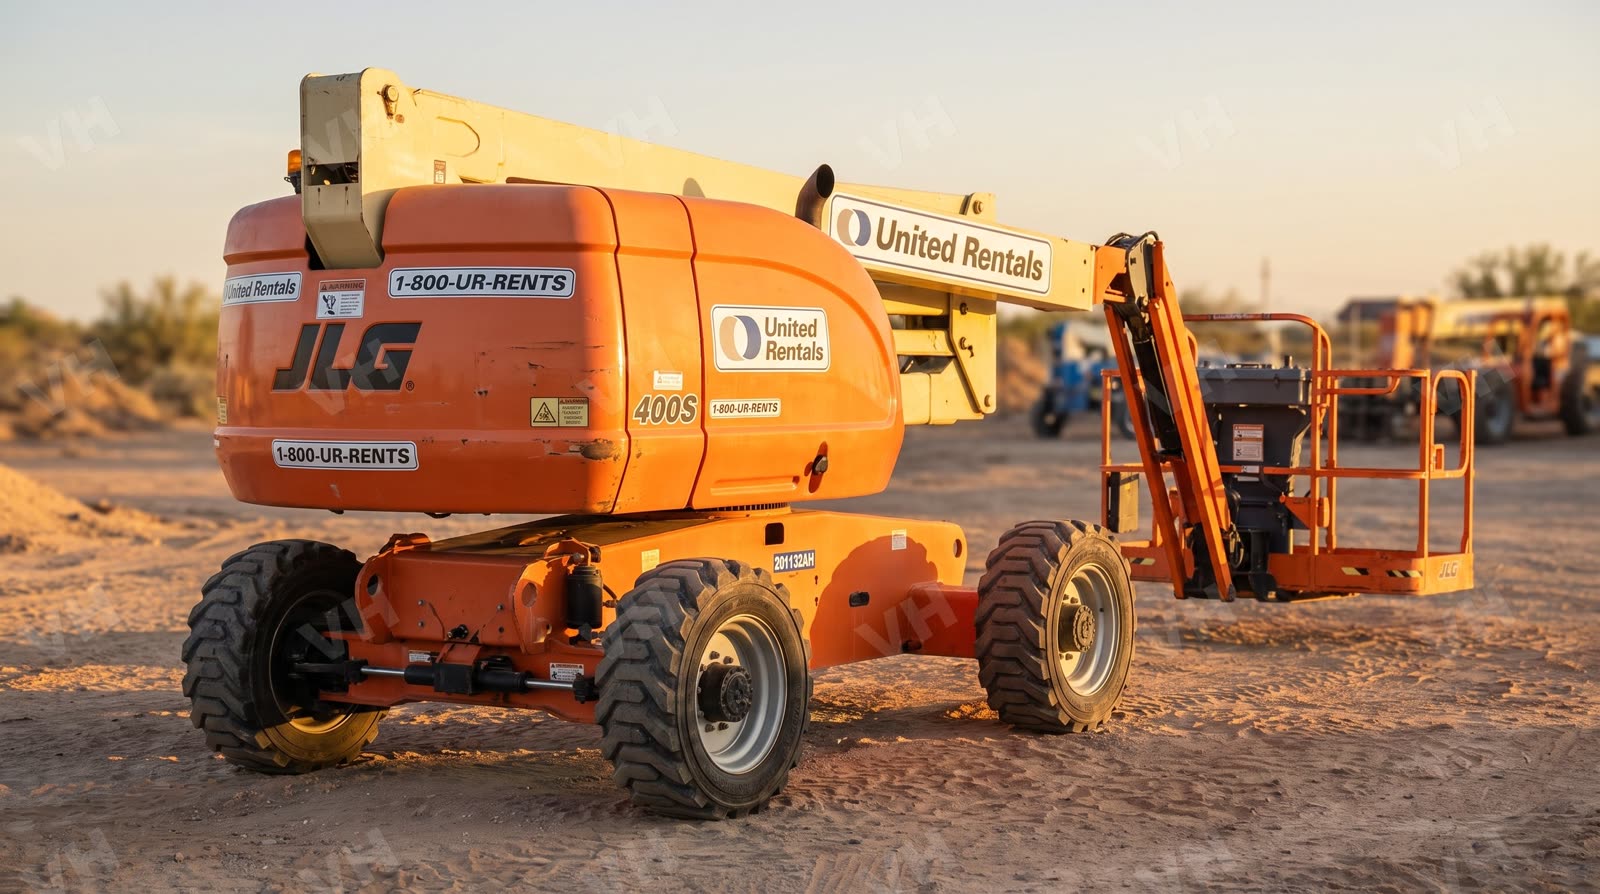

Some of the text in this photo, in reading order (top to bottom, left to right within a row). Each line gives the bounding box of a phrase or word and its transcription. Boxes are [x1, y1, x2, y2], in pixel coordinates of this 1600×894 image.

[876, 216, 1043, 281] United Rentals
[253, 278, 296, 297] Rentals
[395, 273, 567, 292] 1-800-UR-RENTS
[765, 316, 817, 338] United
[272, 322, 423, 391] JLG
[766, 341, 824, 361] Rentals
[634, 394, 698, 424] 400S
[712, 402, 779, 414] 1-800-UR-RENTS
[276, 446, 411, 464] 1-800-UR-RENTS
[774, 552, 815, 571] 201132AH
[1438, 561, 1459, 579] JLG
